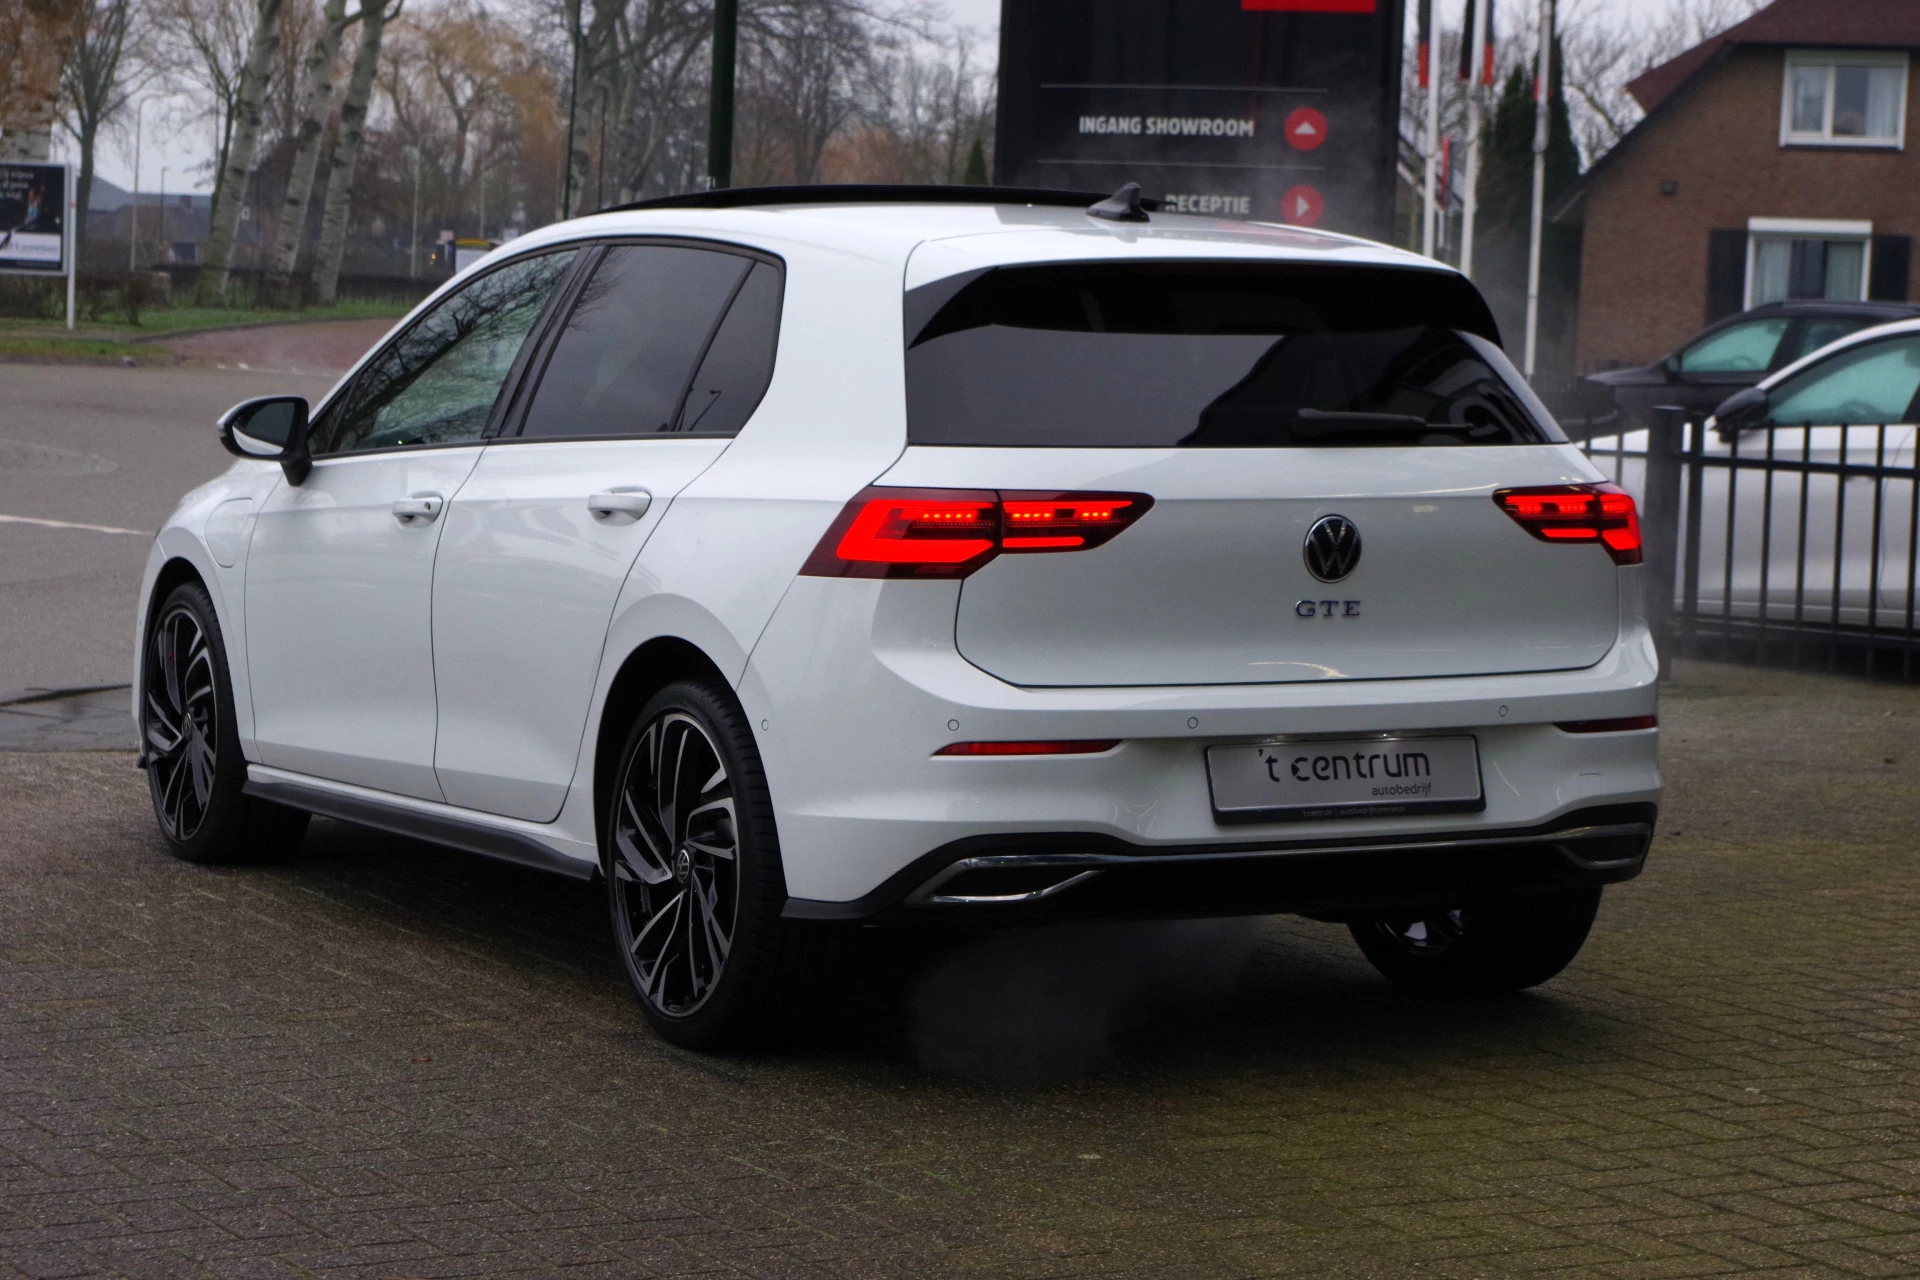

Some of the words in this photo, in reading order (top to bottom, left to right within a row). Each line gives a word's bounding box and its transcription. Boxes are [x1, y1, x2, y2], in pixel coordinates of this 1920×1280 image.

[1078, 116, 1142, 135] INGANG
[1145, 117, 1255, 138] SHOWROOM
[1295, 600, 1361, 617] GTE
[1290, 751, 1431, 781] centrum
[1371, 782, 1432, 797] autobedrijf
